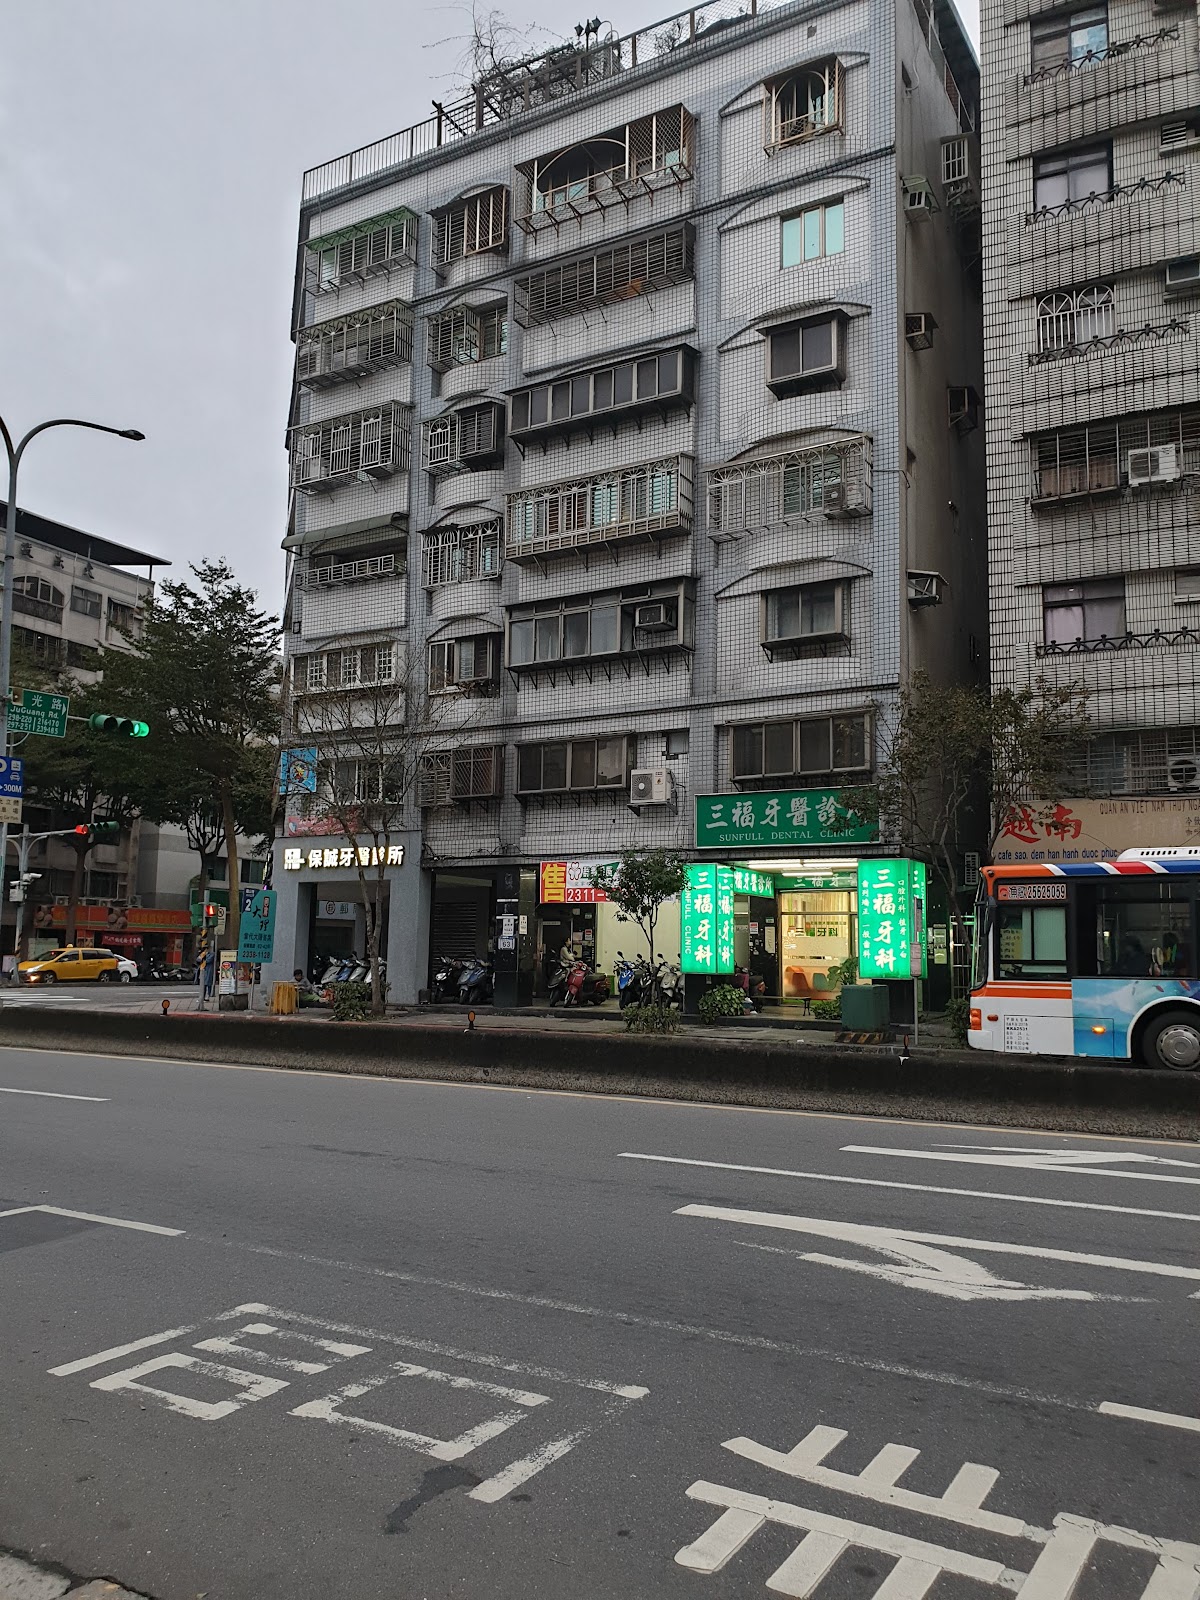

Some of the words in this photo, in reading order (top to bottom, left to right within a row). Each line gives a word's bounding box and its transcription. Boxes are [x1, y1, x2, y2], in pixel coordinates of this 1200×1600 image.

[10, 705, 45, 719] JuGuang
[3, 783, 22, 793] 300M
[705, 795, 864, 829] 三福牙醫診
[1000, 803, 1083, 844] 越南
[719, 832, 764, 842] SUNFULL
[771, 830, 813, 840] DENTAL
[820, 828, 856, 839] CLINIC
[997, 849, 1012, 860] cafe
[541, 862, 567, 902] 售
[694, 871, 714, 967] 三福牙科
[872, 868, 897, 973] 三福牙科
[684, 925, 692, 955] CLINIC
